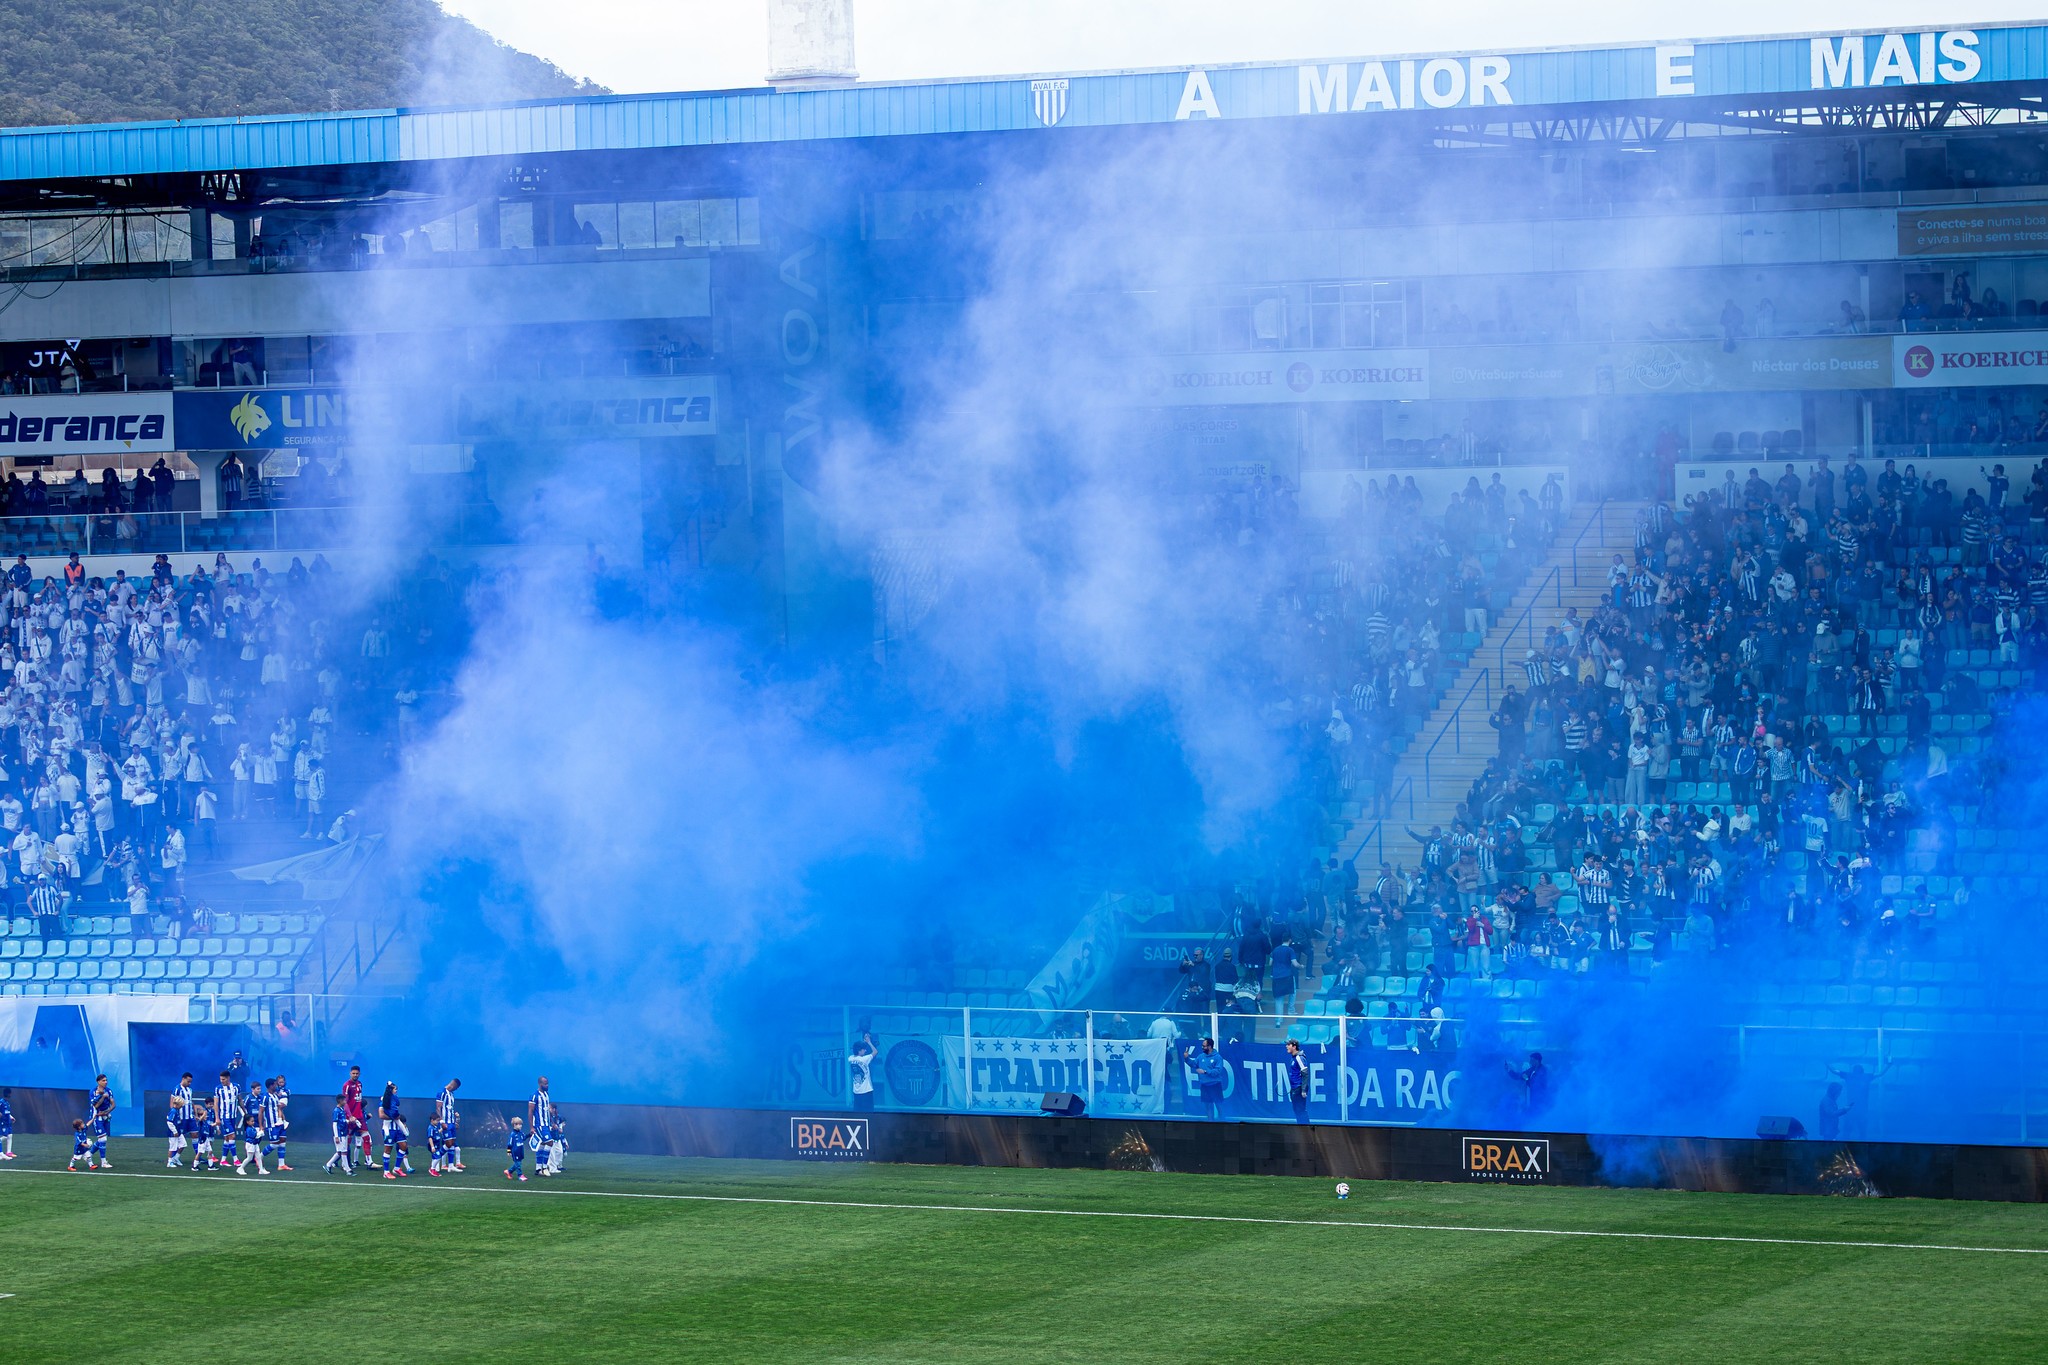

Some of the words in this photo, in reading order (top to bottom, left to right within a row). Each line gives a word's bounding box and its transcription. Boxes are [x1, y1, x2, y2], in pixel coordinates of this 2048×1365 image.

[1175, 72, 1221, 119] A
[1298, 57, 1513, 113] MAIOR
[1656, 45, 1694, 96] E
[1811, 31, 1981, 88] MAIS
[1917, 218, 1984, 230] Conecte-se
[1988, 217, 2021, 227] numa
[2025, 215, 2046, 225] boa
[1918, 237, 1924, 245] e
[1927, 234, 1949, 244] viva
[1953, 235, 1959, 243] a
[1962, 232, 1982, 243] ilha
[1985, 232, 2010, 242] sem
[1752, 358, 1799, 372] Néctar
[1802, 358, 1826, 371] dos
[1830, 358, 1879, 371] Deuses
[1941, 350, 2048, 368] KOERICH
[1172, 371, 1272, 388] KOERICH
[1320, 368, 1423, 384] KOERICH
[798, 1124, 862, 1150] BRAX
[1470, 1144, 1542, 1172] BRAX
